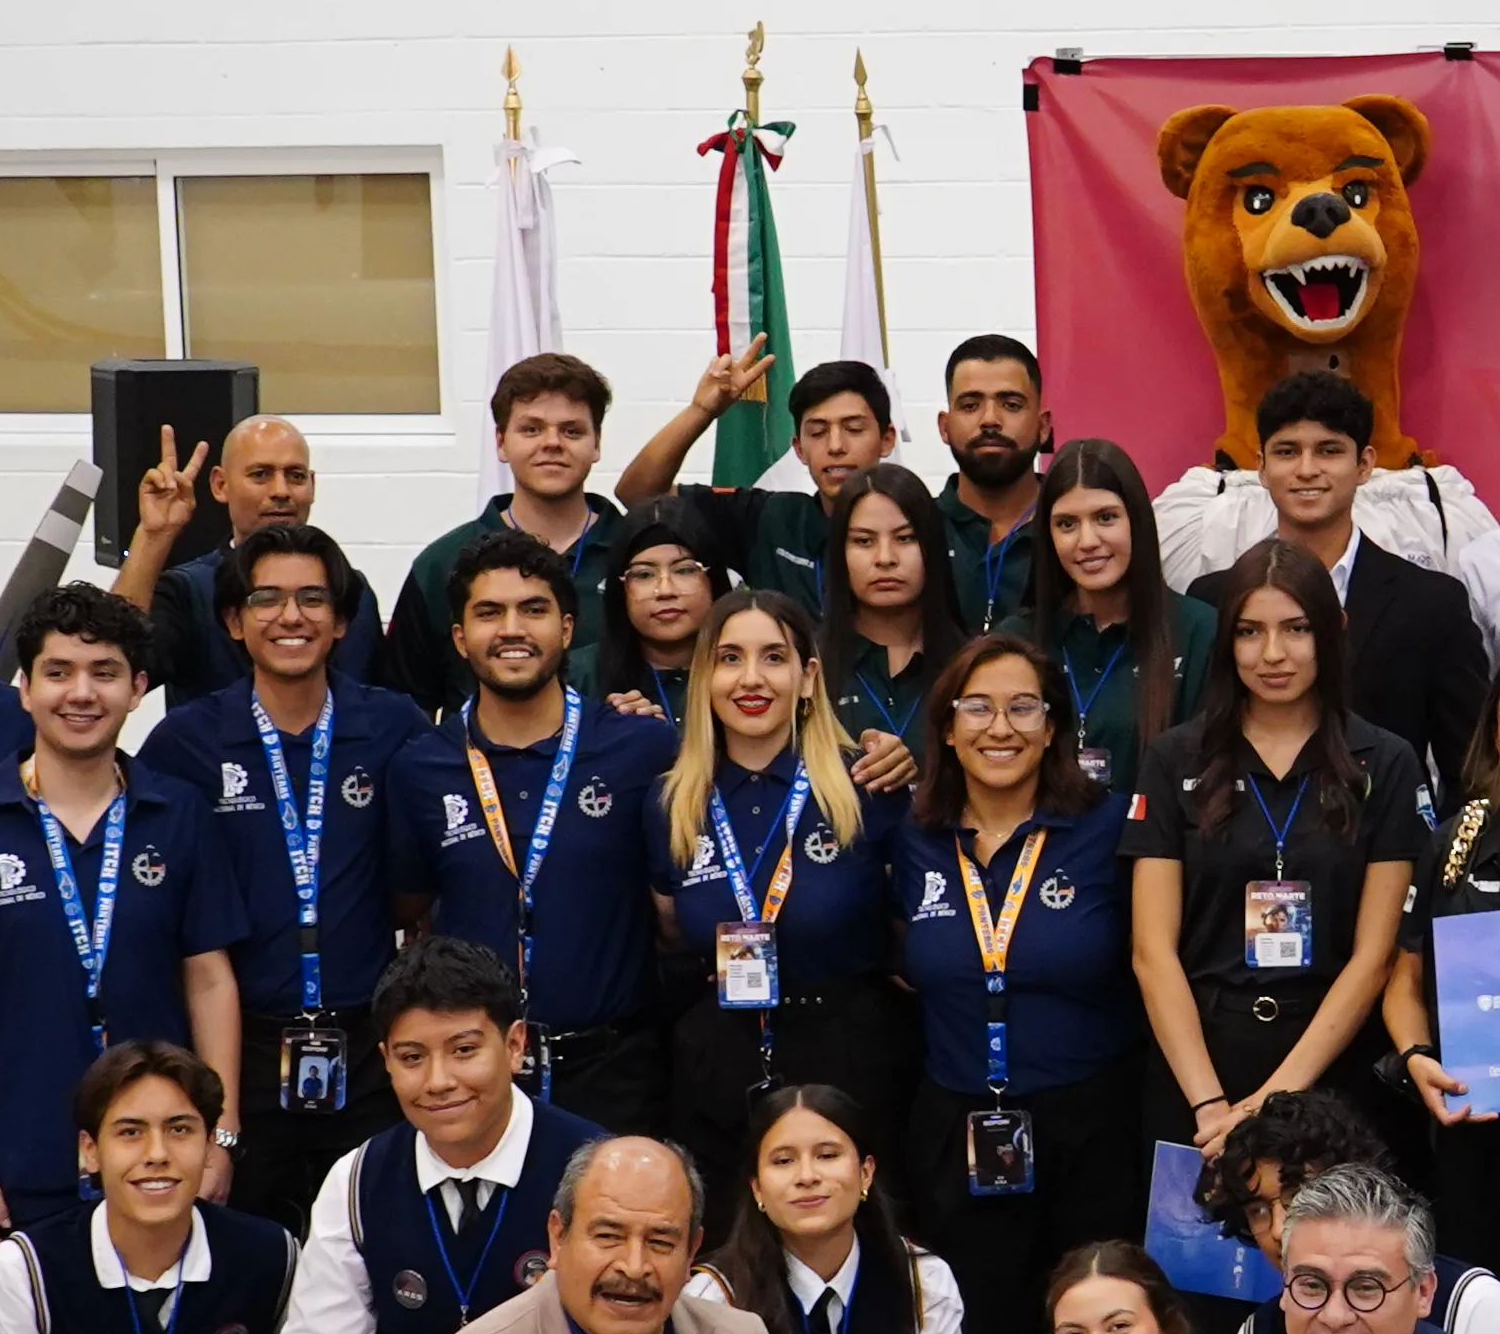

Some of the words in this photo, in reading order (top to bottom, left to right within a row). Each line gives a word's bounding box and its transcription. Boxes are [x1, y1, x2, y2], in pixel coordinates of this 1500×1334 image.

[253, 701, 274, 733] ITCH
[307, 779, 325, 815] ITCH
[475, 766, 495, 800] ITCH
[535, 800, 558, 836] ITCH
[100, 842, 120, 878] ITCH
[289, 850, 309, 886] ITCH
[1251, 891, 1273, 900] RETO
[1274, 892, 1305, 900] MARTE
[68, 919, 91, 956] ITCH
